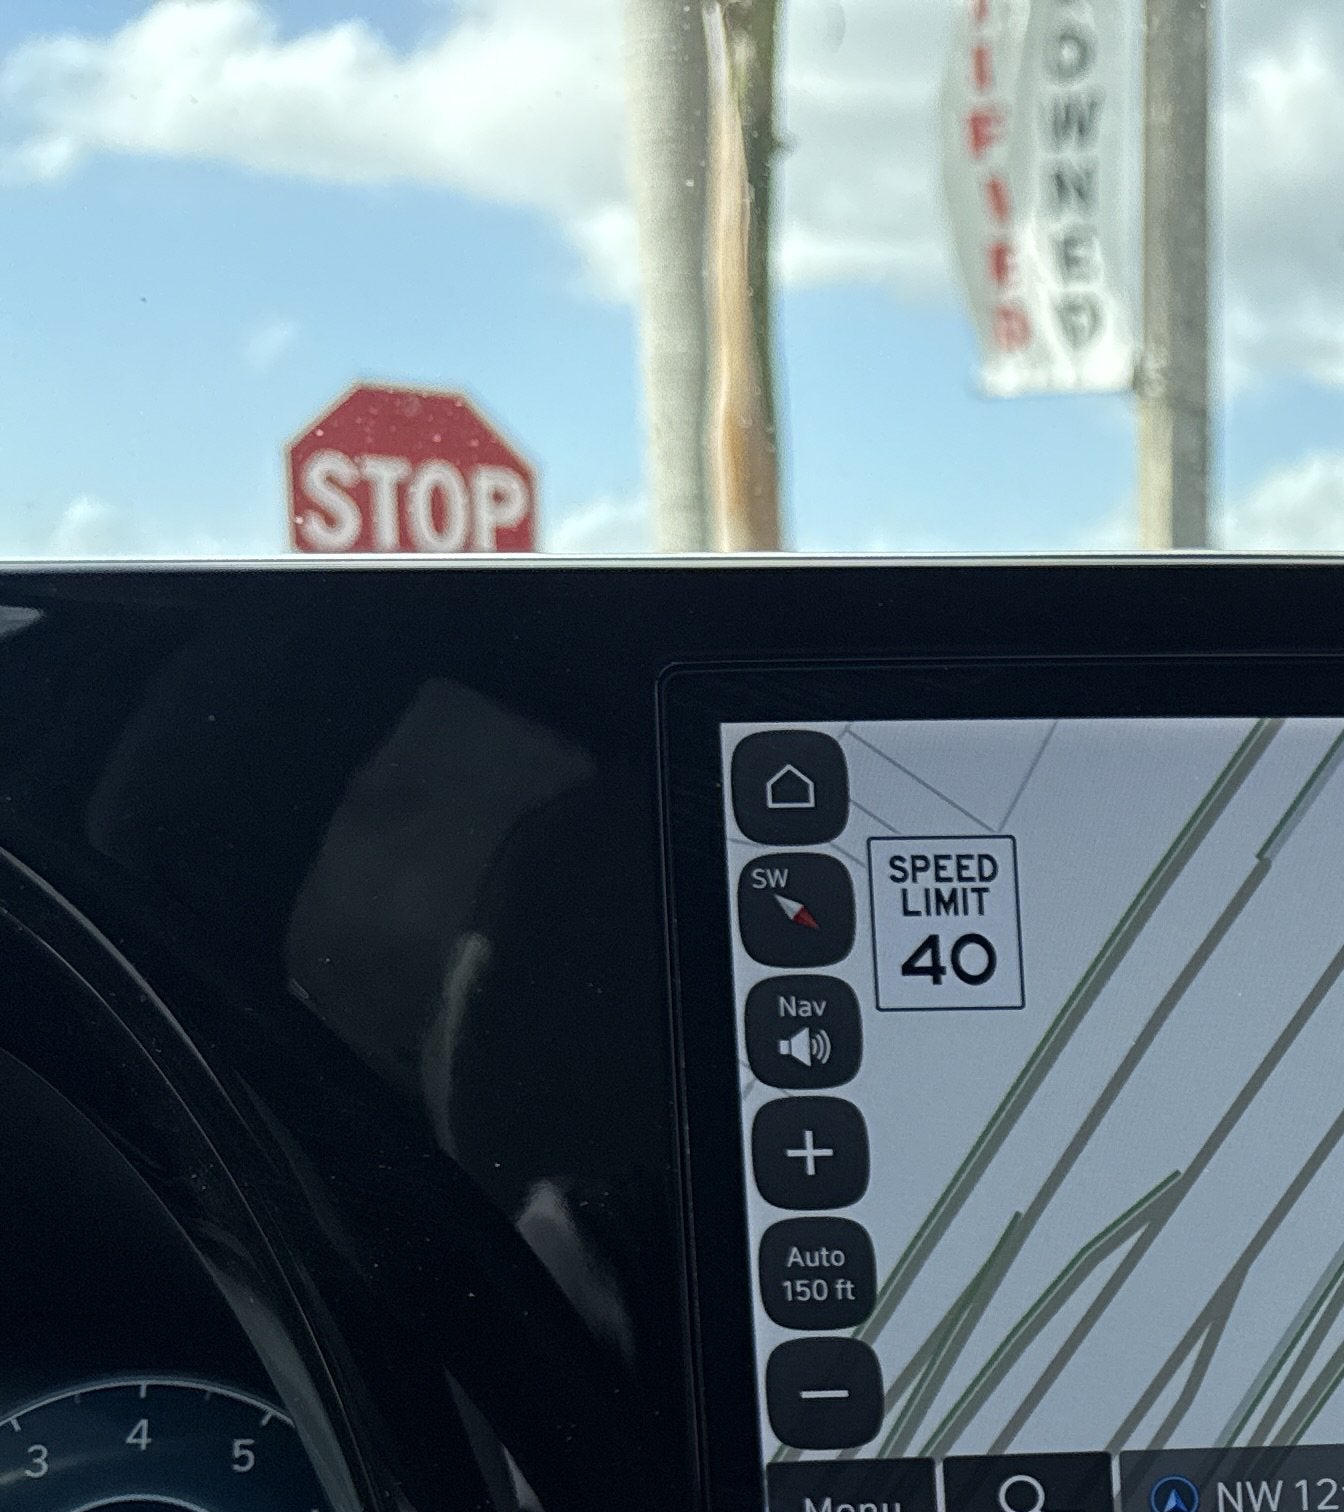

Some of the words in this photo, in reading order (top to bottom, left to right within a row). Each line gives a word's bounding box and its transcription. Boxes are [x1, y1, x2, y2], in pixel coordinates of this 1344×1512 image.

[301, 449, 529, 552] STOP
[751, 869, 789, 890] SW
[889, 853, 999, 884] SPEED
[901, 888, 990, 917] LIMIT
[901, 933, 998, 986] 40
[779, 996, 827, 1017] Nav
[786, 1245, 846, 1269] Auto
[782, 1280, 828, 1303] 150
[834, 1278, 857, 1302] ft
[125, 1418, 152, 1450] 4
[24, 1444, 49, 1479] 3
[231, 1437, 256, 1473] 5
